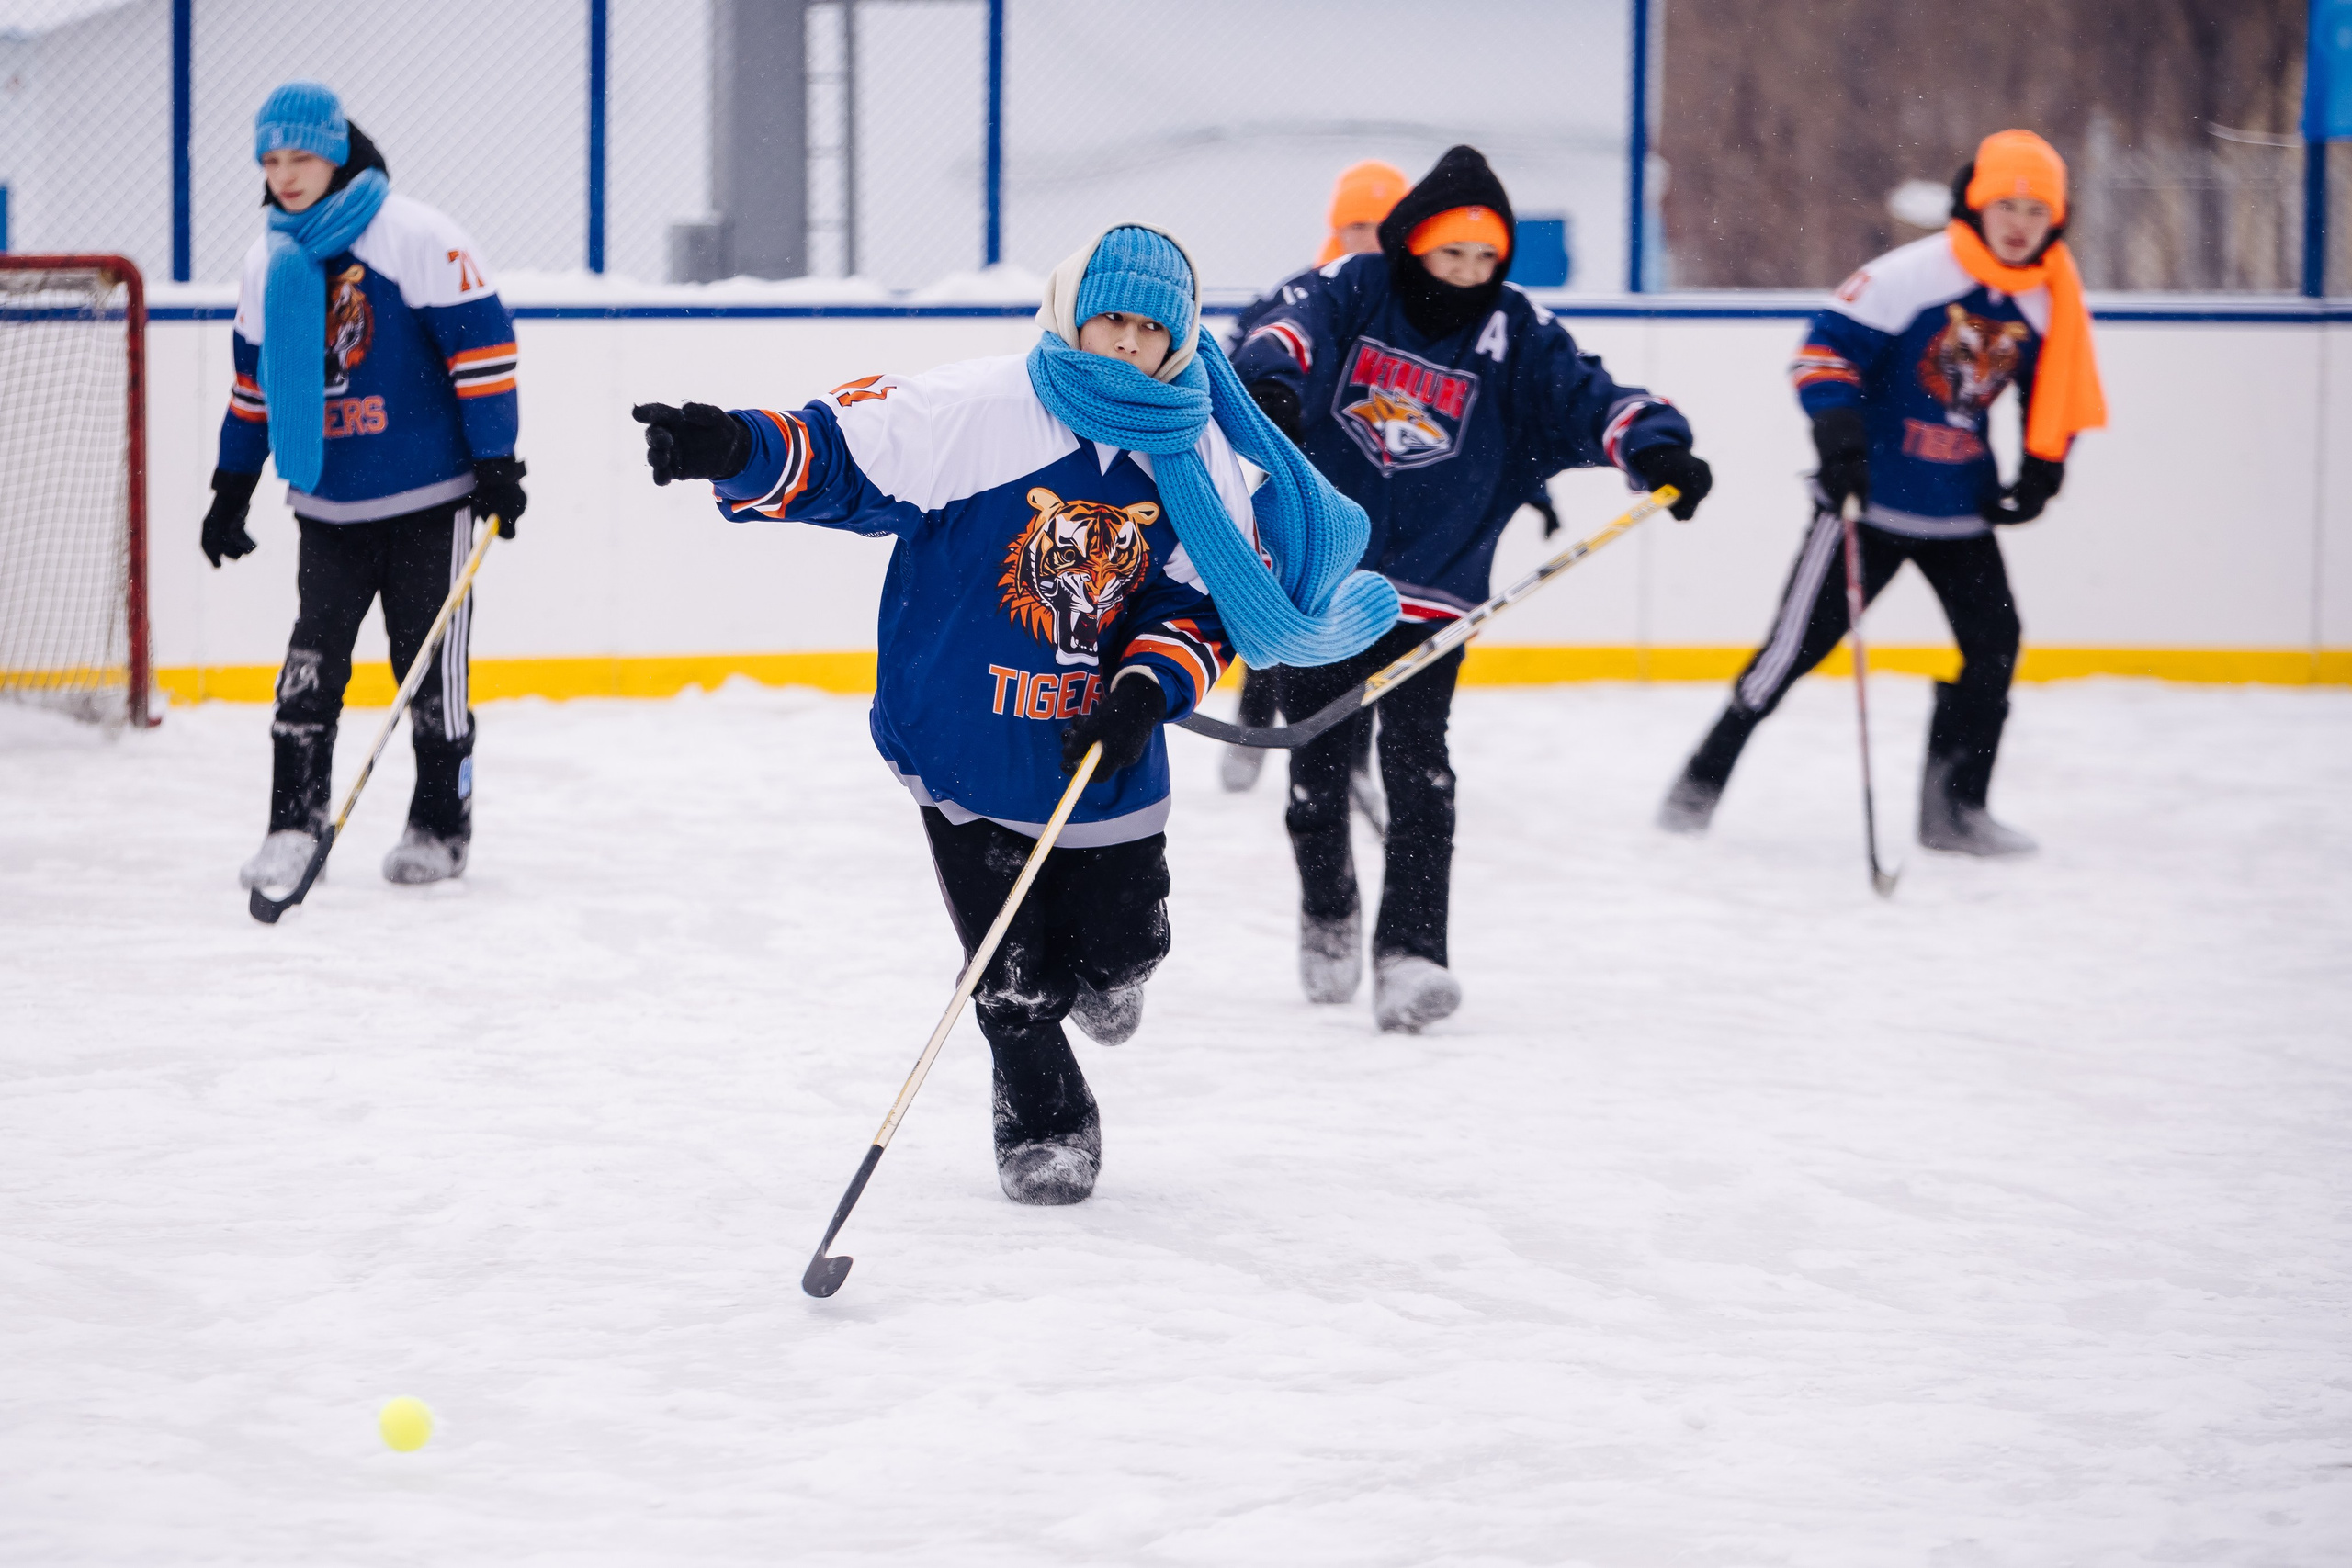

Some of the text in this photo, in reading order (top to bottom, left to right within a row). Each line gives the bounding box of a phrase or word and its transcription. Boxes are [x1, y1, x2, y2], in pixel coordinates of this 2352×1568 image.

[1474, 310, 1509, 363] A
[322, 395, 389, 439] ERS
[989, 663, 1102, 720] TIGER
